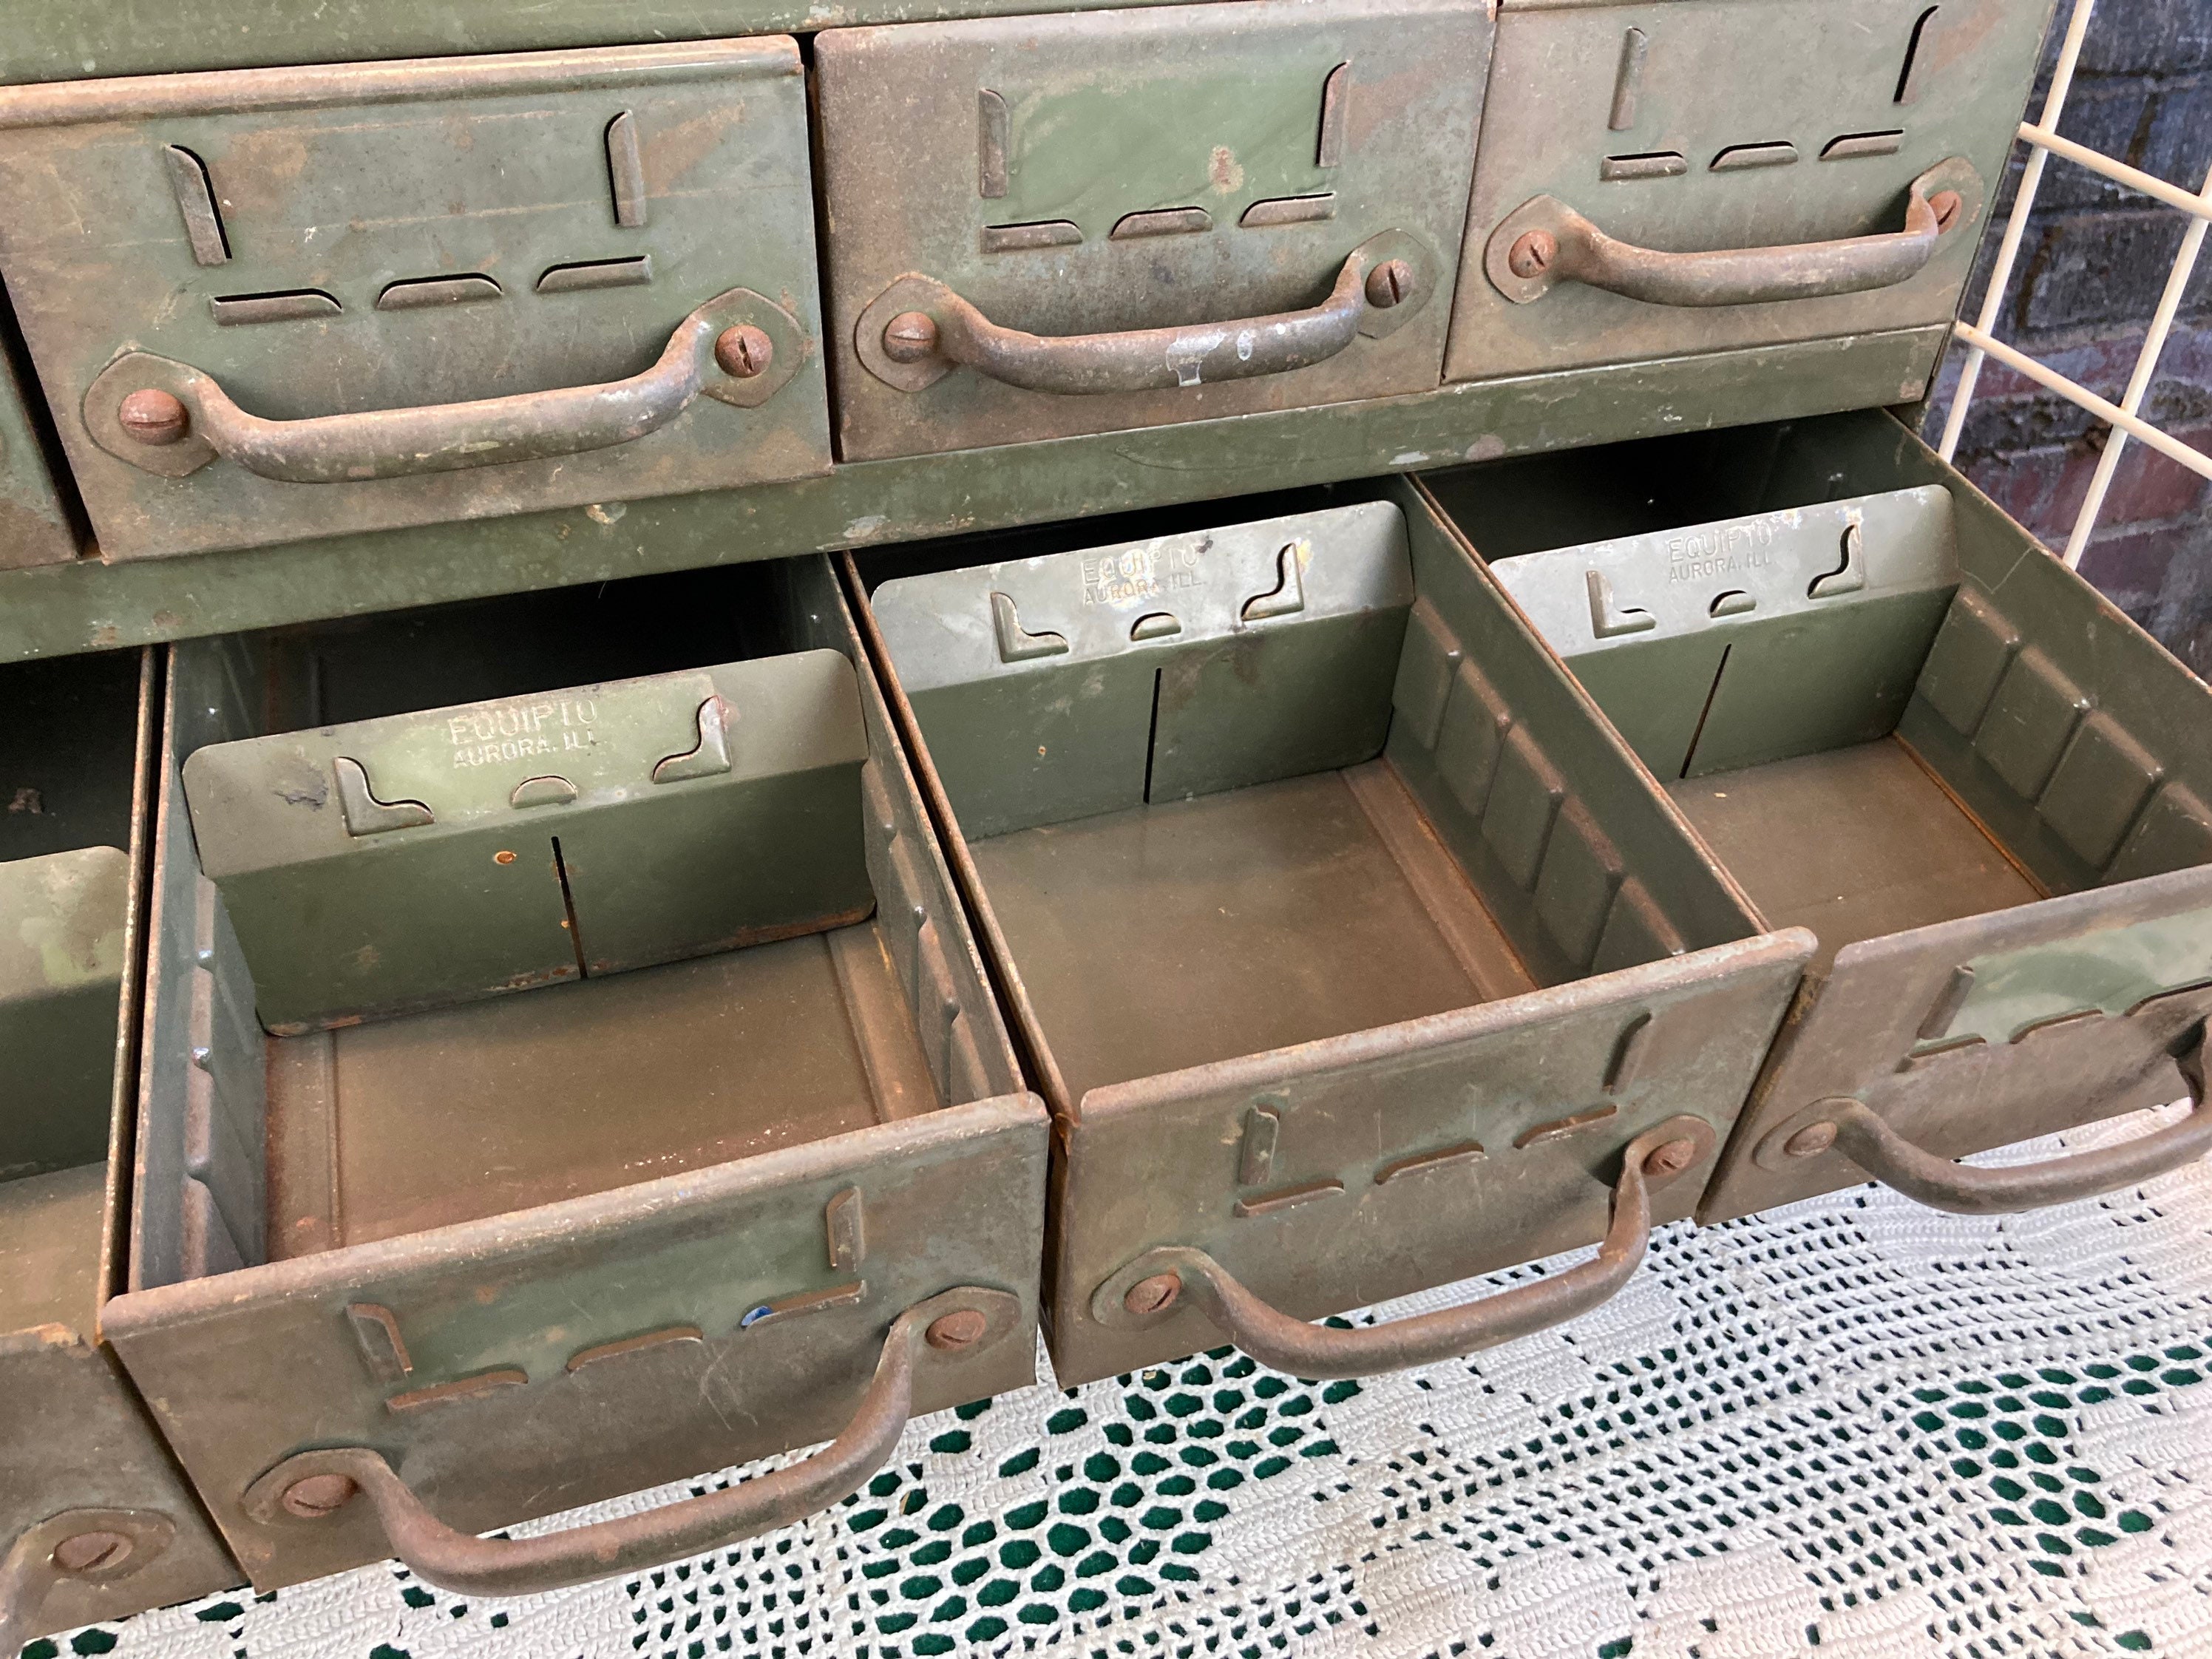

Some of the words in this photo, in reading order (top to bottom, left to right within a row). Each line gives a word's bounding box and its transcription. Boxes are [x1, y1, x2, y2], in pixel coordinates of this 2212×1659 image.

[1667, 521, 1771, 563] EQUIPTO
[1080, 543, 1201, 586] EQUIPTO
[447, 699, 597, 745] EQUIPTO
